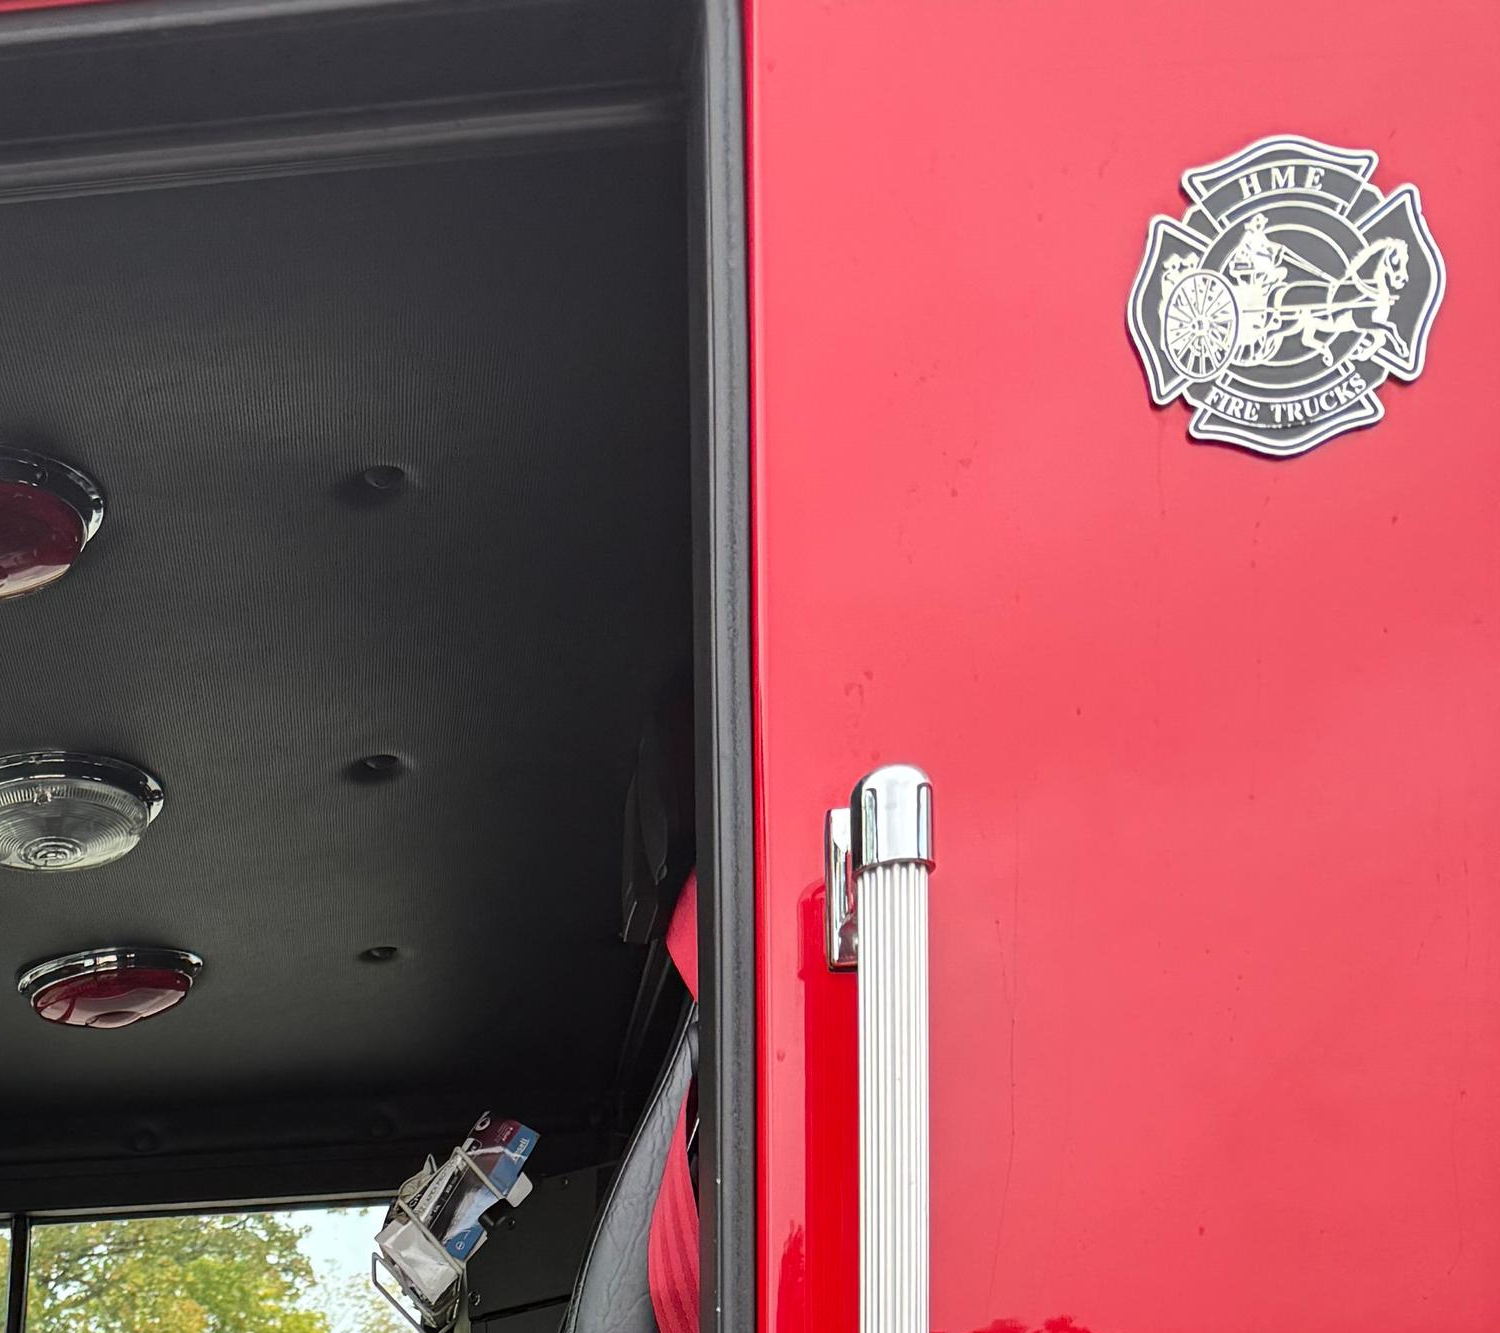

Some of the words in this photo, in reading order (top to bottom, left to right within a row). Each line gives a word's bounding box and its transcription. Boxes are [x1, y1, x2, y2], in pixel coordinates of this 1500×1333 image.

[1238, 166, 1325, 200] HME
[1207, 386, 1260, 423] FIRE
[1270, 372, 1369, 424] TRUCKS
